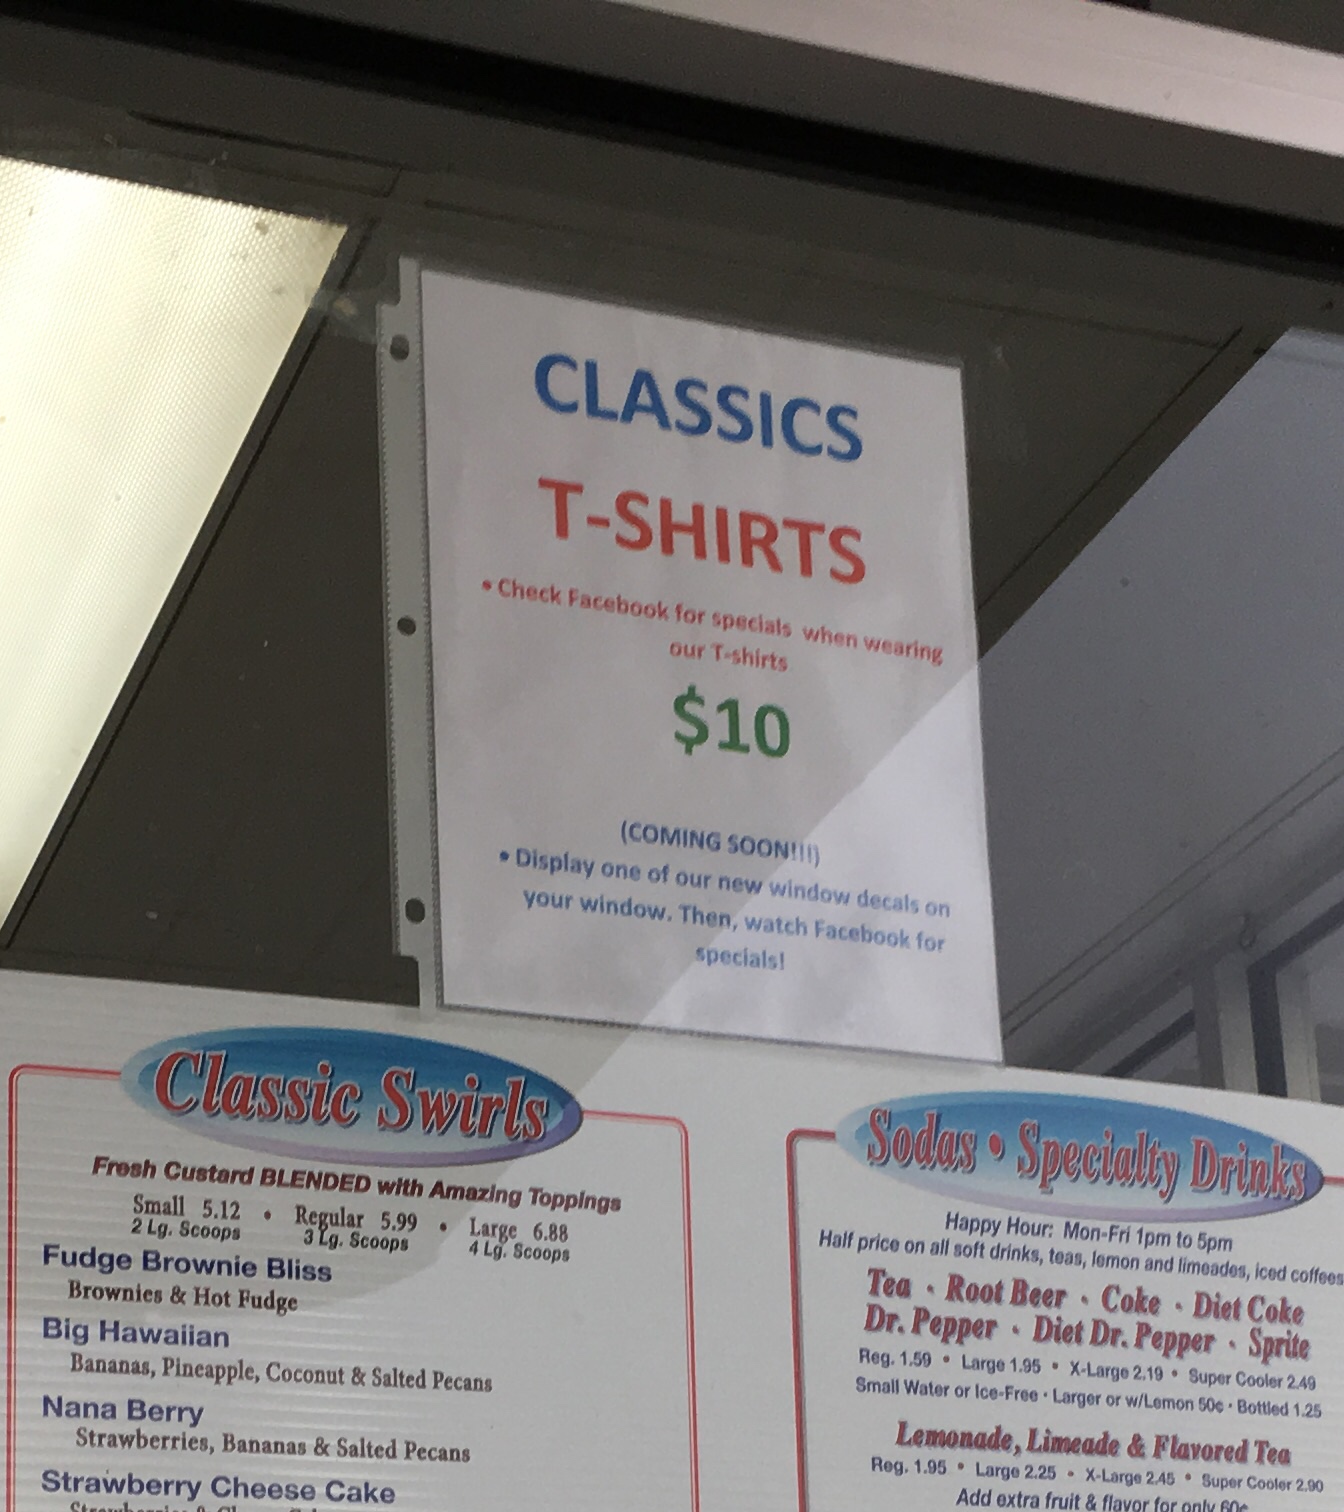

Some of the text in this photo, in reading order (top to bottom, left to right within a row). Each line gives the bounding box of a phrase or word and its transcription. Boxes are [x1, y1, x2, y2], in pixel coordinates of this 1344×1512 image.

[535, 354, 862, 462] CLASSICS
[538, 477, 865, 584] T-SHIRTS
[498, 578, 943, 666] Check Facebook for specials when wearing
[670, 642, 788, 672] our T-shirts
[674, 685, 790, 758] $10
[621, 820, 721, 852] (COMING
[516, 848, 950, 918] Display one of our new window decals on
[523, 890, 945, 953] your window. Then, watch Facebook for
[695, 945, 784, 970] specials!
[154, 1050, 549, 1142] Classic Swirls
[867, 1108, 1306, 1202] Sodas Specialty Drinks
[44, 1244, 332, 1282] Fudge Brownie Bliss
[946, 1212, 1233, 1254] Happy Hour: Mon-Fri 1pm to 5pm
[68, 1280, 297, 1316] Brownies & Hot Fudge
[868, 1268, 1304, 1325] Tea Root Beer Coke Diet Coke
